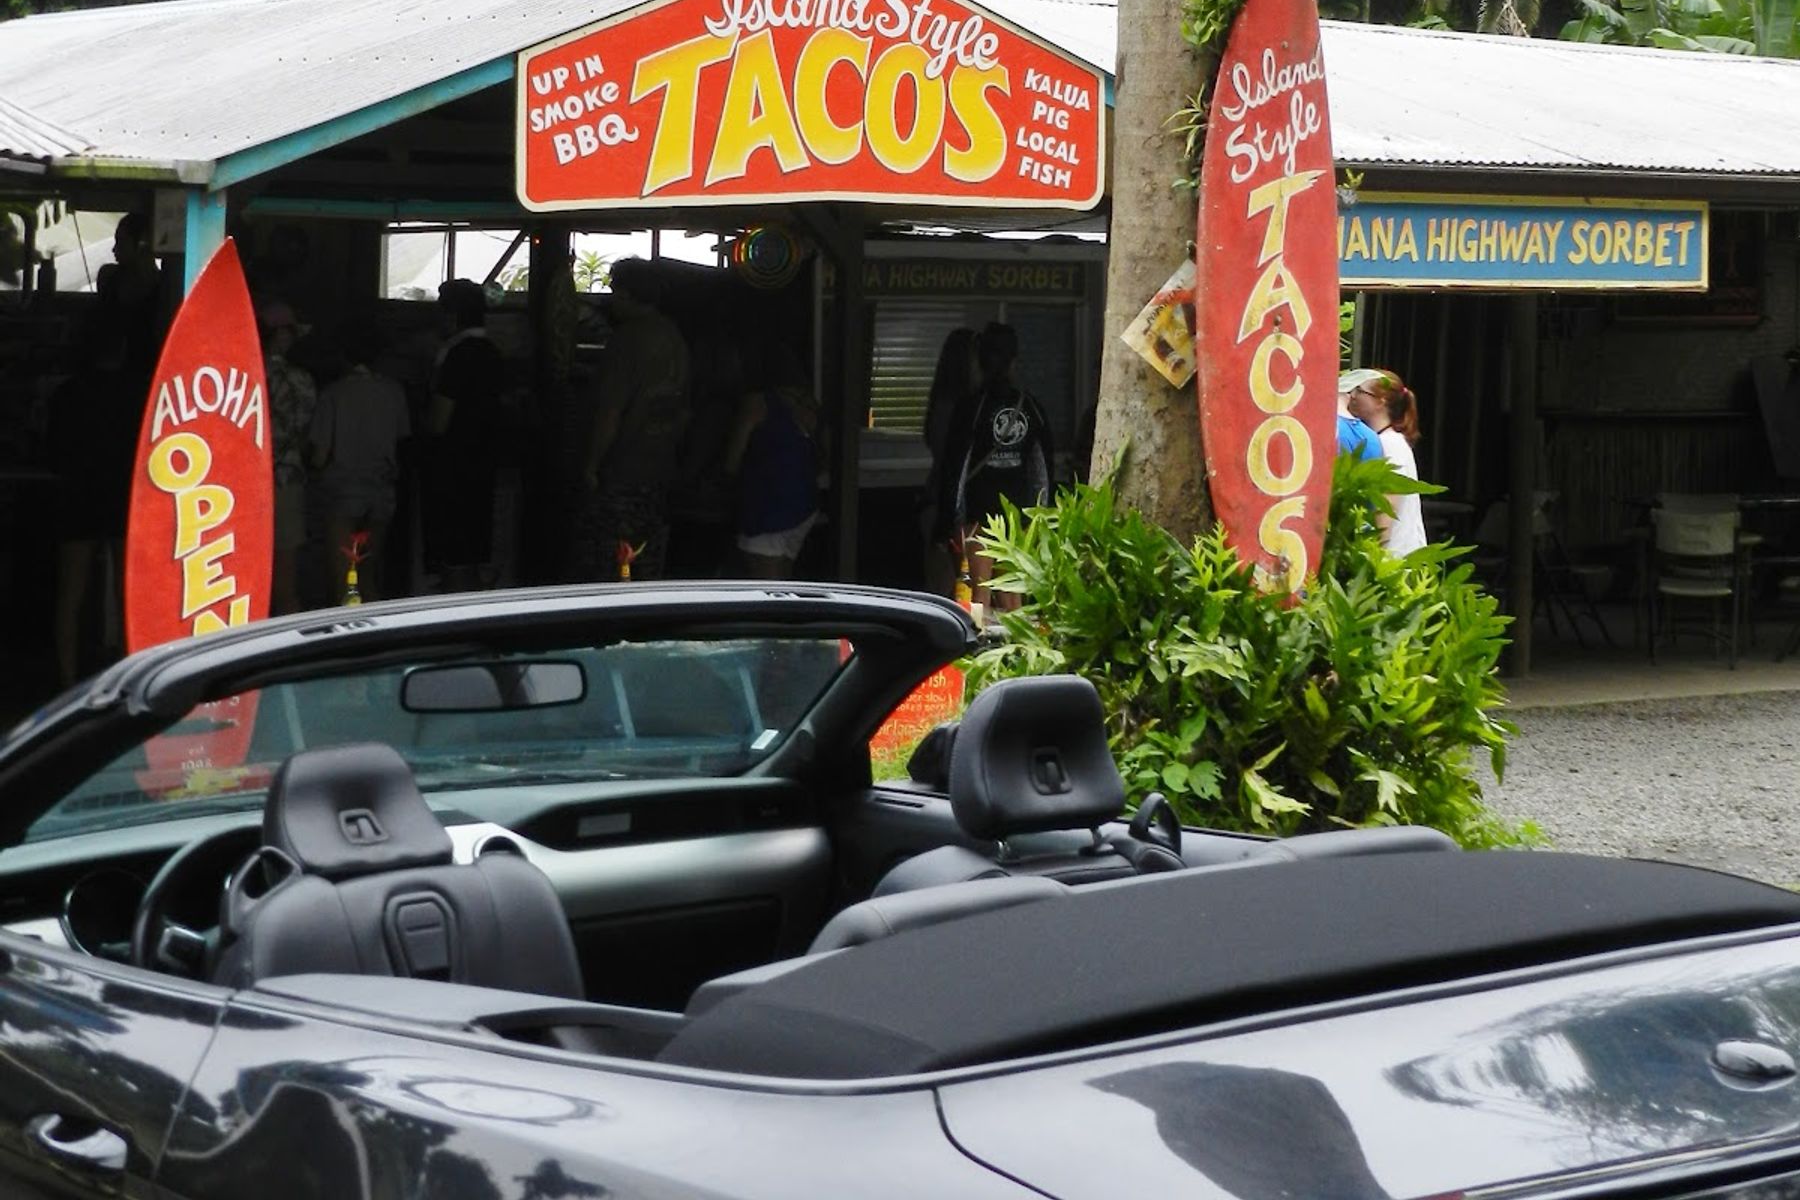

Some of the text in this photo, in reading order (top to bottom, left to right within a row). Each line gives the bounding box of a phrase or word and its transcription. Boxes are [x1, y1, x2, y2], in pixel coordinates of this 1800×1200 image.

[531, 54, 605, 95] UP IN
[1024, 67, 1091, 111] KALUA
[1221, 41, 1325, 122] Island
[630, 27, 1012, 199] TACOS
[1032, 100, 1071, 130] PIG
[1225, 90, 1322, 184] Style
[553, 113, 640, 165] BBQ
[1016, 125, 1081, 166] LOCAL
[1018, 155, 1073, 189] FISH
[1426, 218, 1565, 264] HIGHWAY
[1567, 220, 1696, 268] SORBET
[887, 264, 979, 290] HIGHWAY
[986, 264, 1080, 290] SORBET
[1236, 169, 1328, 596] TACOS
[151, 366, 264, 451] ALOHA
